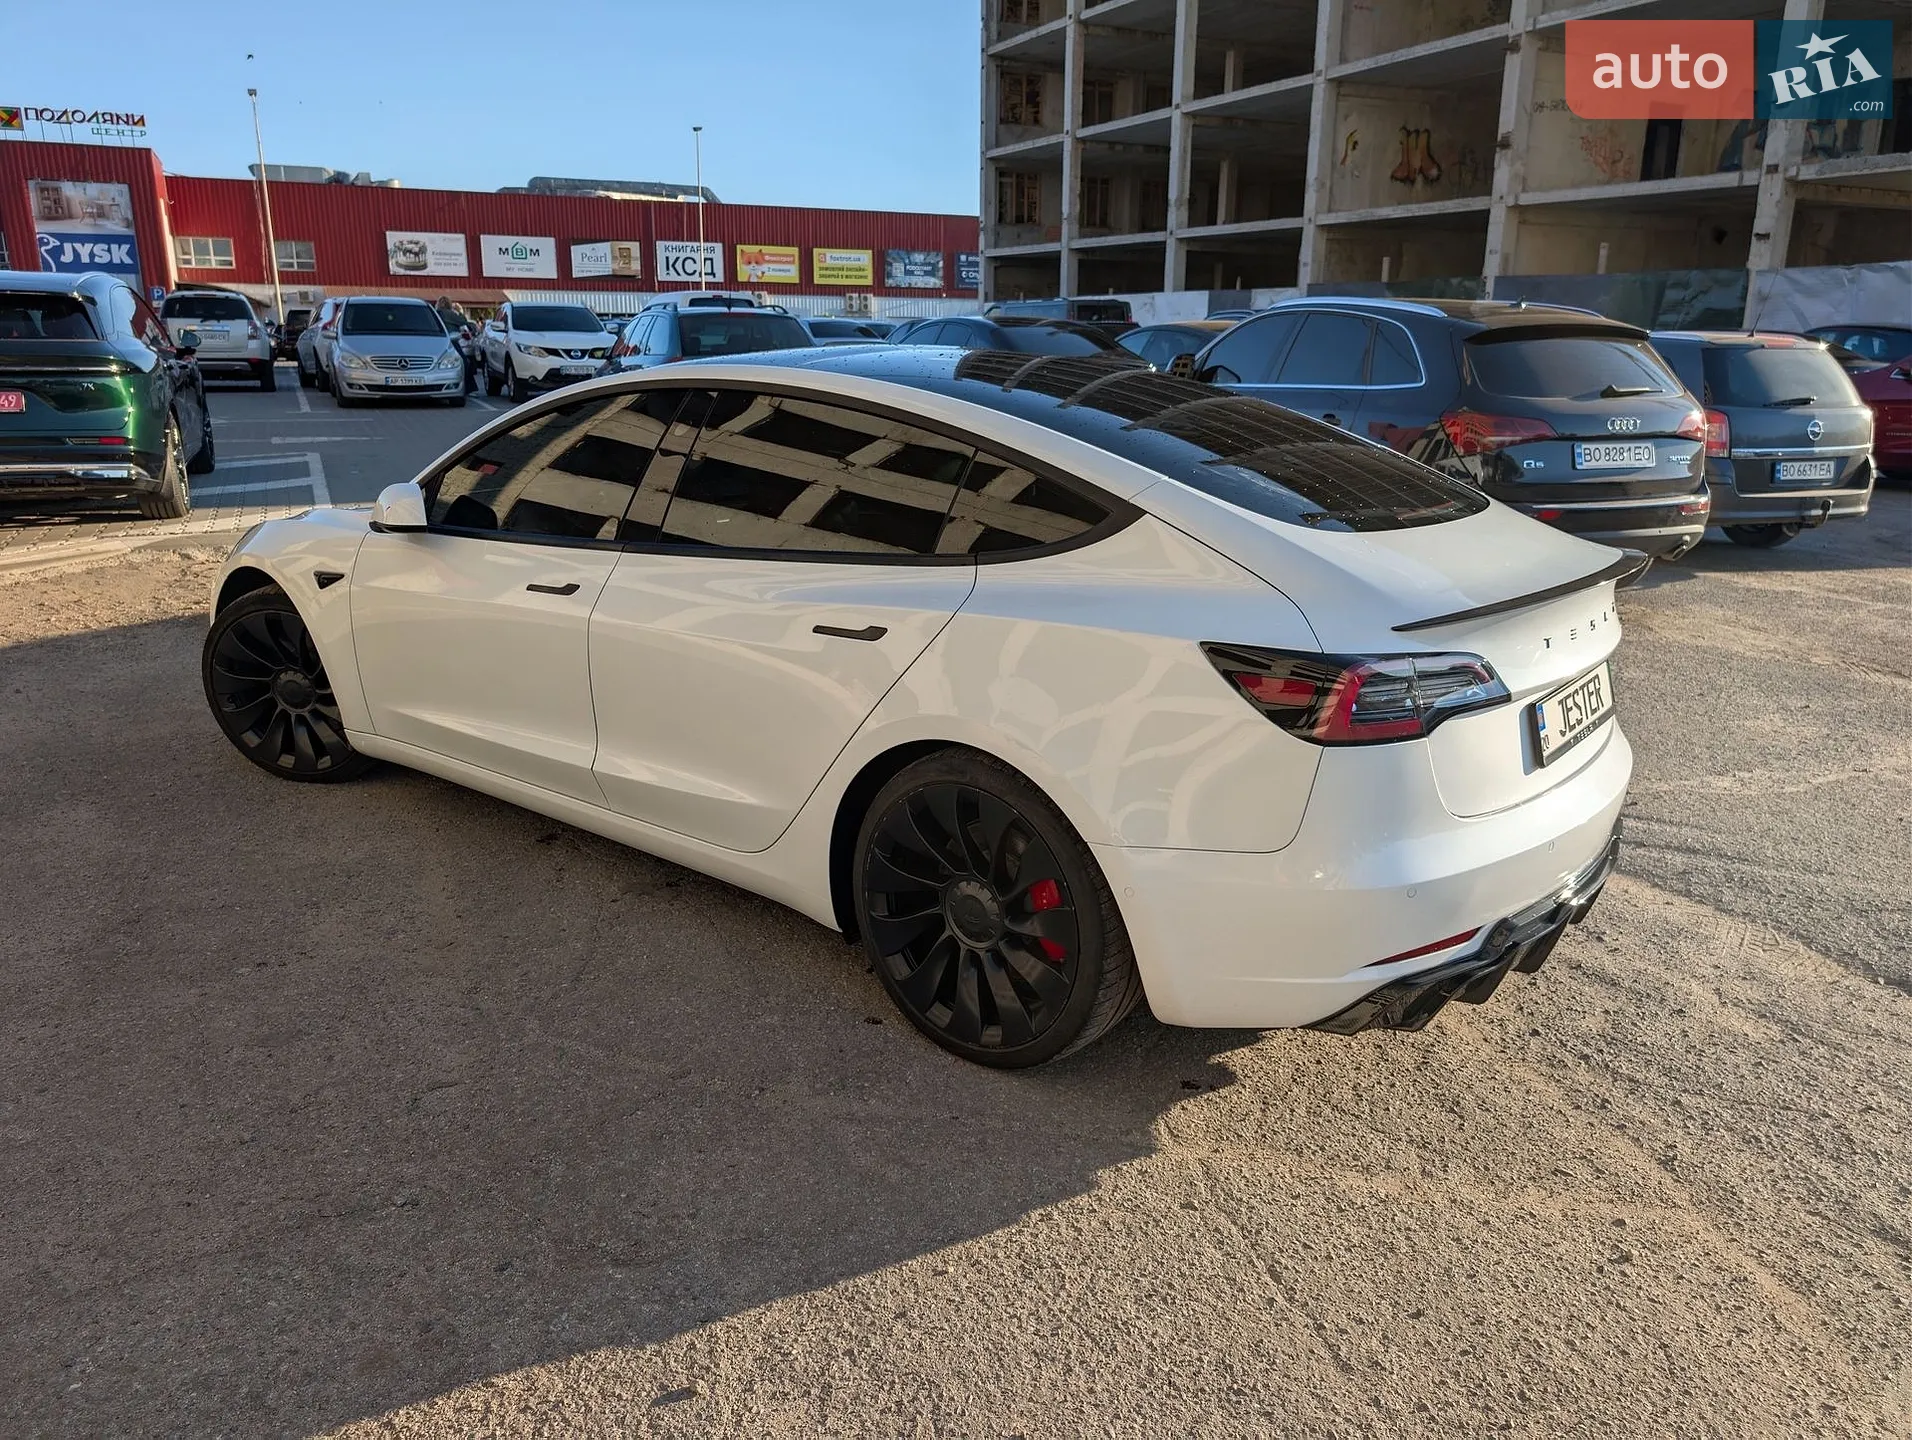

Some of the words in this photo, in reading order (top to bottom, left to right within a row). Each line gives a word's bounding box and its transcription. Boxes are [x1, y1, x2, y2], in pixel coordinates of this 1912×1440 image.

[91, 127, 147, 138] ЦЕНТР
[60, 243, 134, 264] JYSK
[664, 244, 716, 254] КНИГАРНЯ
[581, 252, 607, 263] Pearl
[1557, 673, 1605, 738] JESTER
